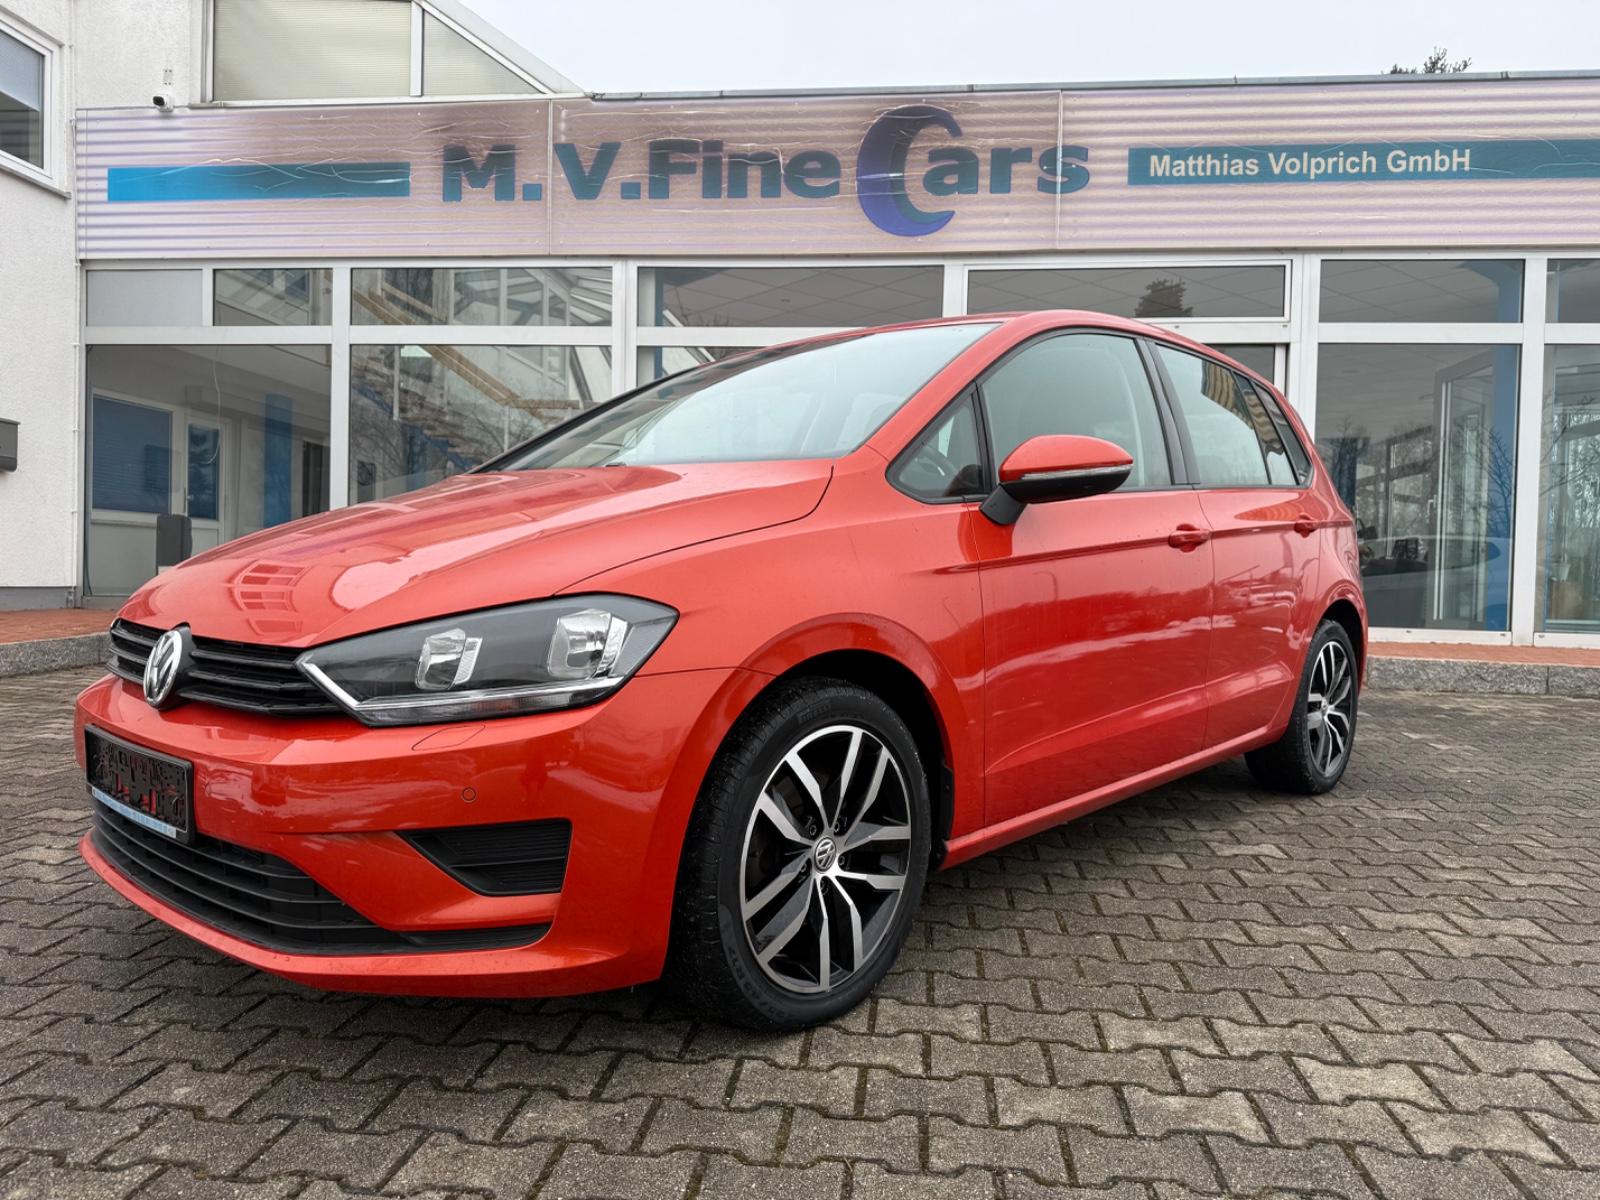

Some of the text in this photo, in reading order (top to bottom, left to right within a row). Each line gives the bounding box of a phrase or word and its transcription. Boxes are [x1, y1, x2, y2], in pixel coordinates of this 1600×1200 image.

[1150, 148, 1471, 179] Matthias Volprich GmbH
[144, 631, 182, 705] VW
